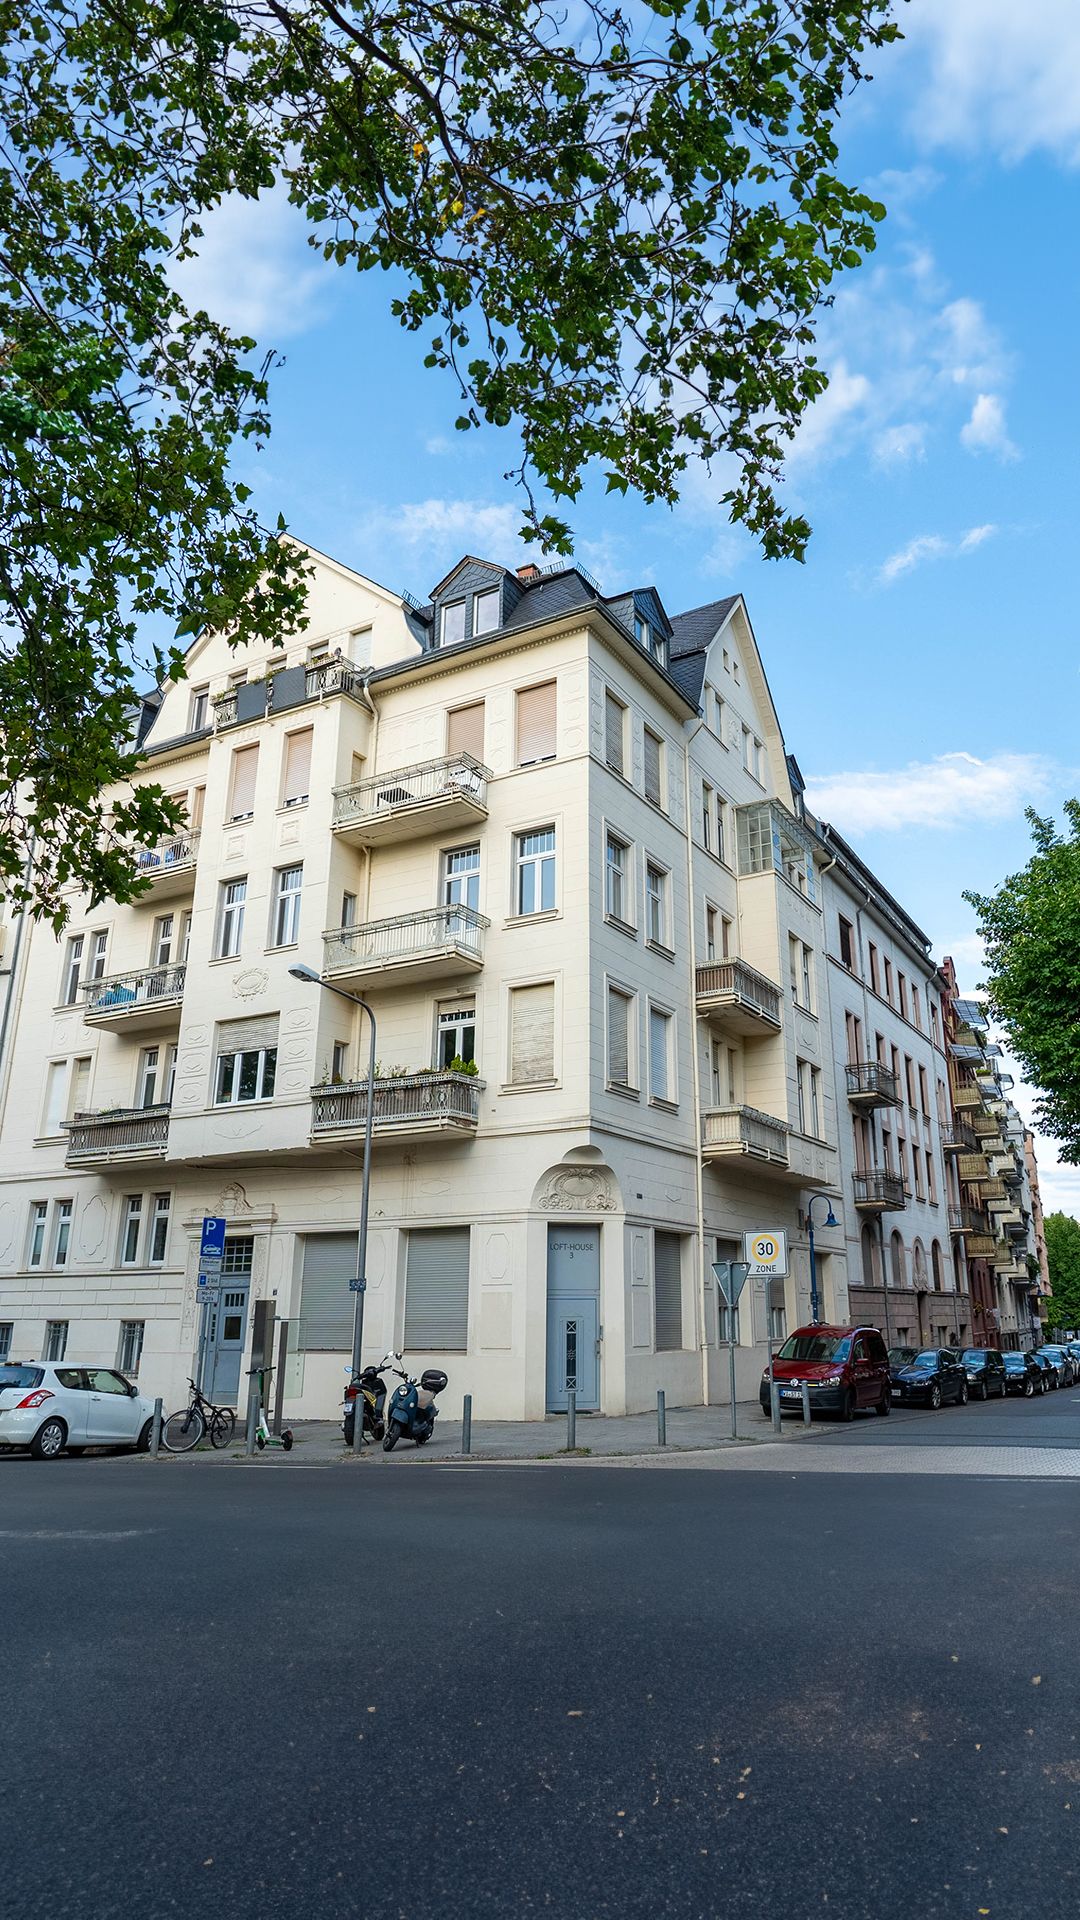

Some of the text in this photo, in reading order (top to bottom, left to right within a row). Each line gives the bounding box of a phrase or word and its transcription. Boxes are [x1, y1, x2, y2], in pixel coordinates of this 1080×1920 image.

[206, 1220, 216, 1235] P
[550, 1243, 593, 1251] LOFT-HOUSE
[757, 1242, 773, 1256] 30
